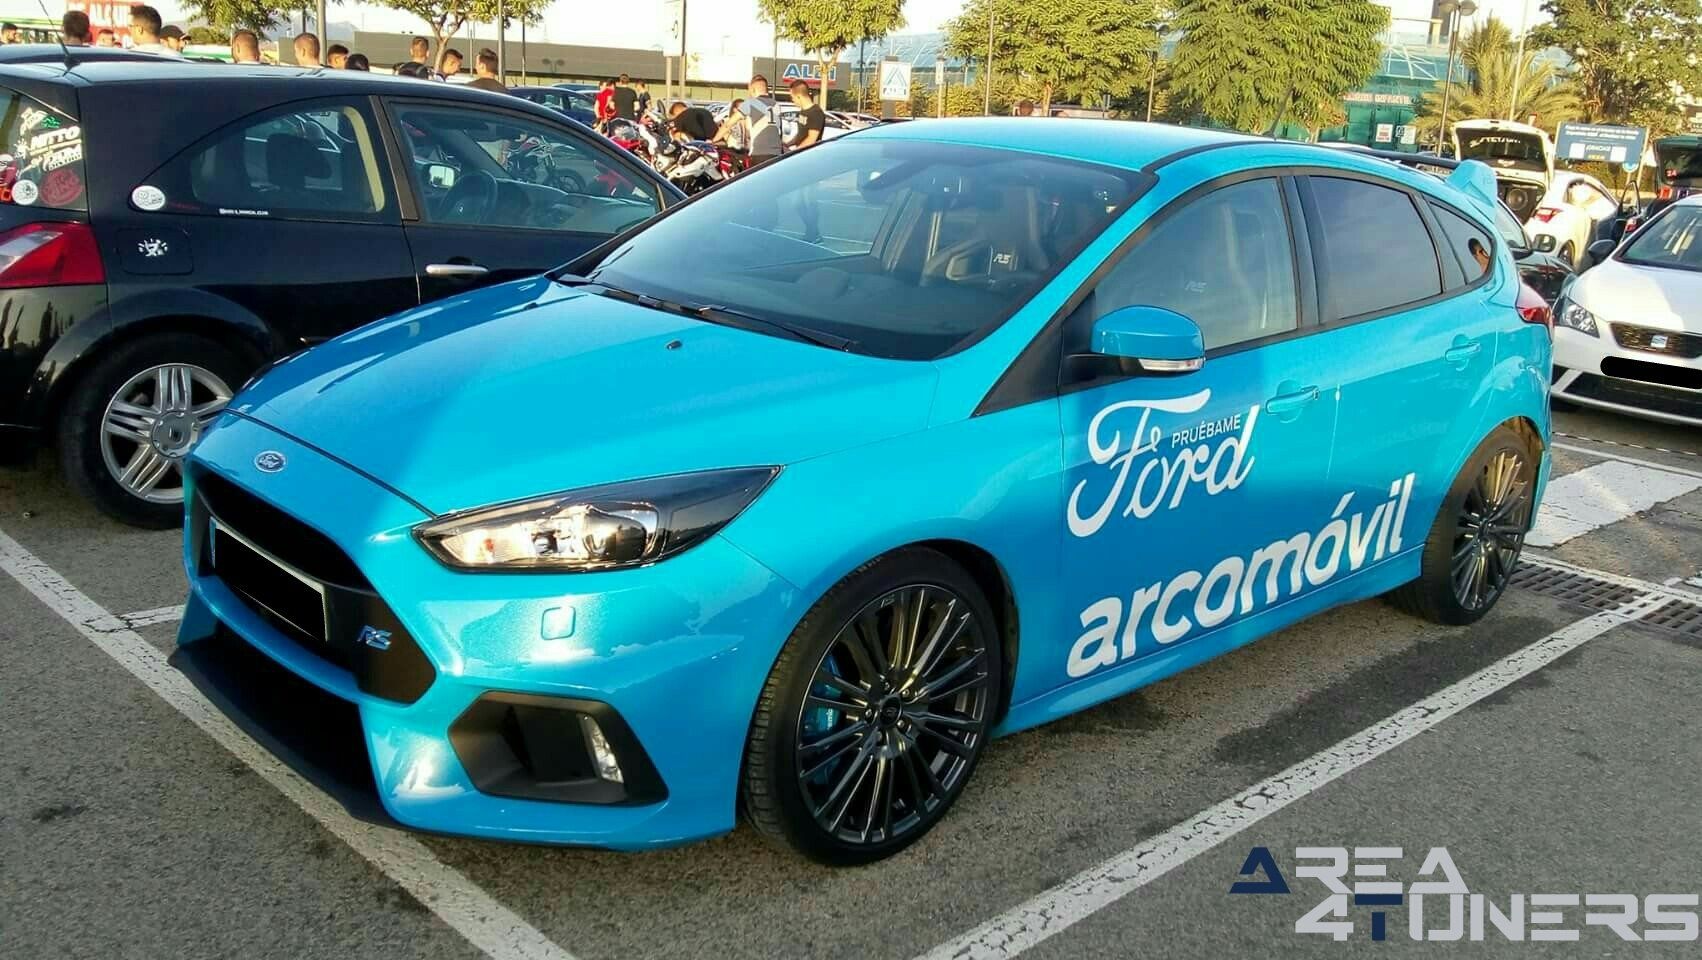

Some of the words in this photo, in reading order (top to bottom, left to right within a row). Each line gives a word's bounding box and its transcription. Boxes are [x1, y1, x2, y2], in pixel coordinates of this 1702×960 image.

[1066, 388, 1261, 538] Ford
[1171, 413, 1241, 449] PRUÉBAME
[1066, 472, 1415, 678] arcomóvil
[356, 625, 392, 650] RS
